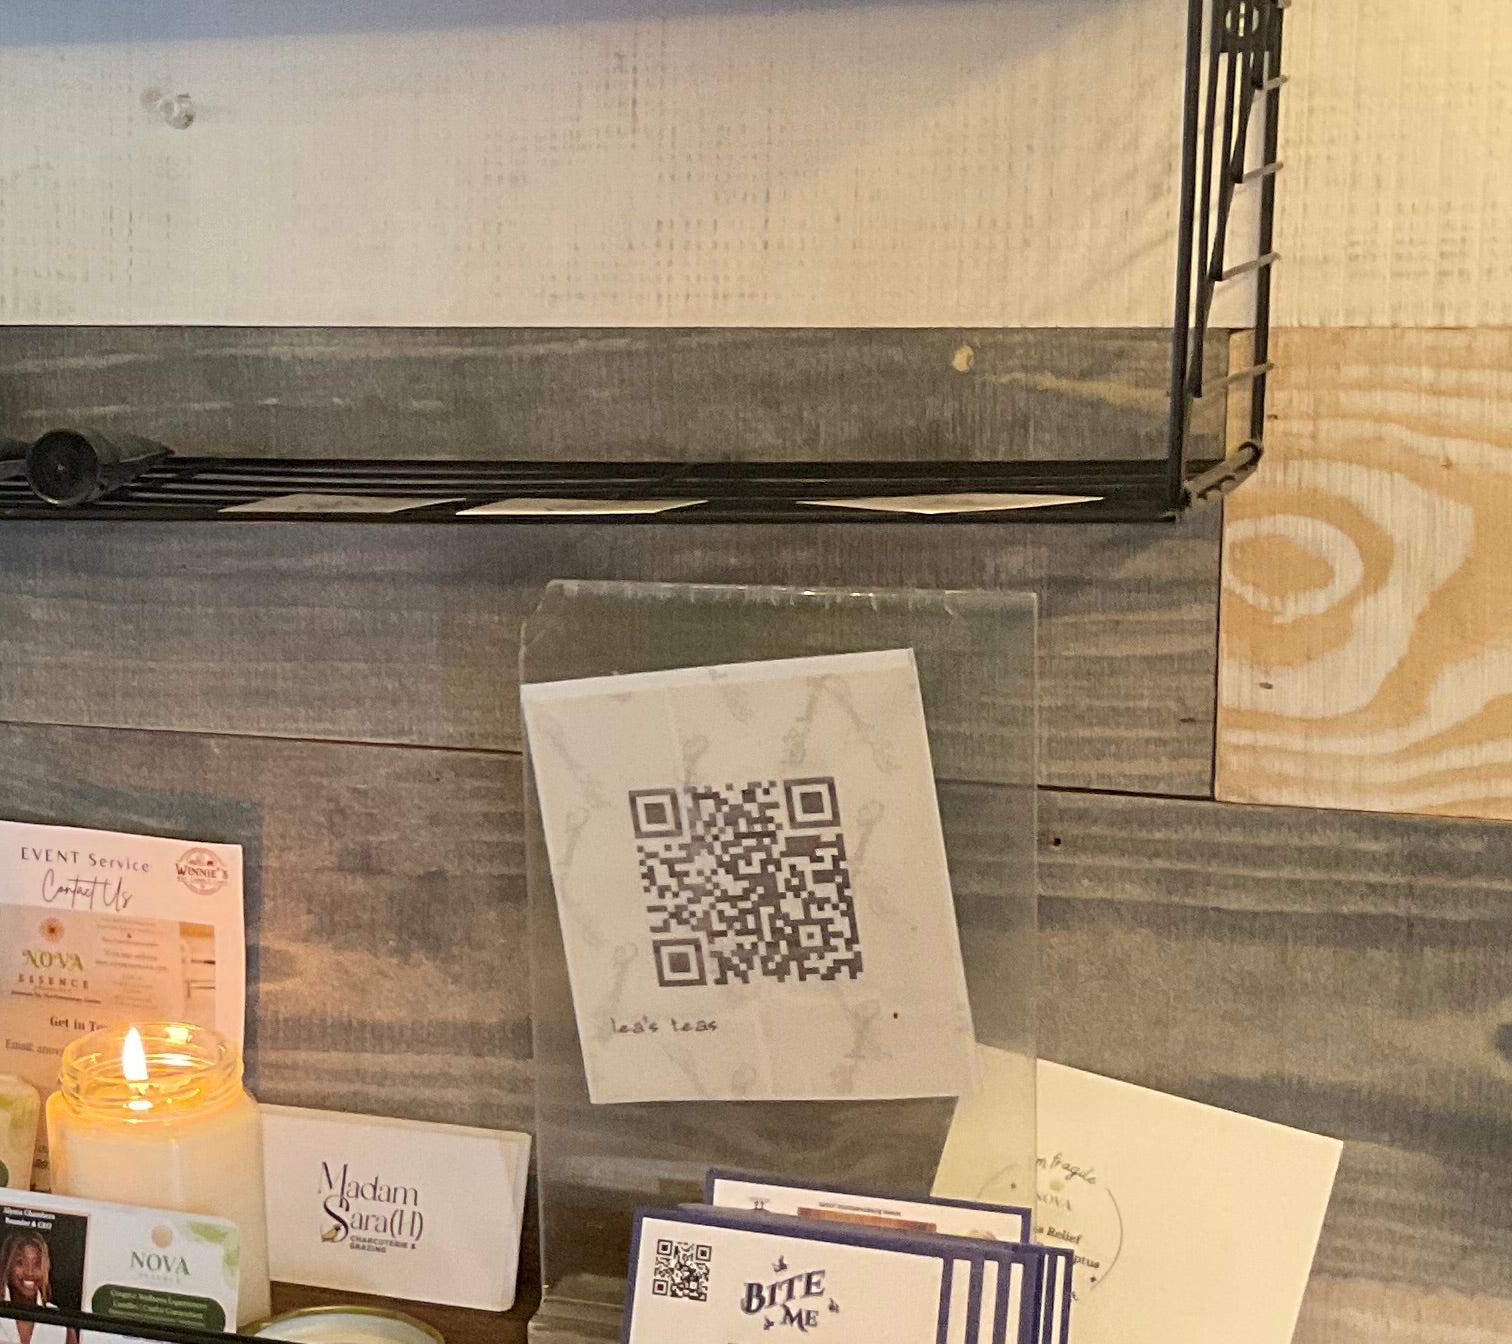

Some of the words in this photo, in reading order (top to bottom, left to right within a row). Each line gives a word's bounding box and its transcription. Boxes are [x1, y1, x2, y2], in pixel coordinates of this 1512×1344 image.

[21, 846, 80, 864] EVENT
[88, 853, 150, 873] Service
[41, 868, 109, 910] Contact
[102, 877, 133, 912] Us
[21, 948, 85, 972] NOVA
[317, 1161, 419, 1209] Madam
[1046, 1226, 1084, 1245] Relief
[130, 1250, 192, 1277] NOVA
[738, 1268, 827, 1317] BITE
[780, 1302, 820, 1333] ME
